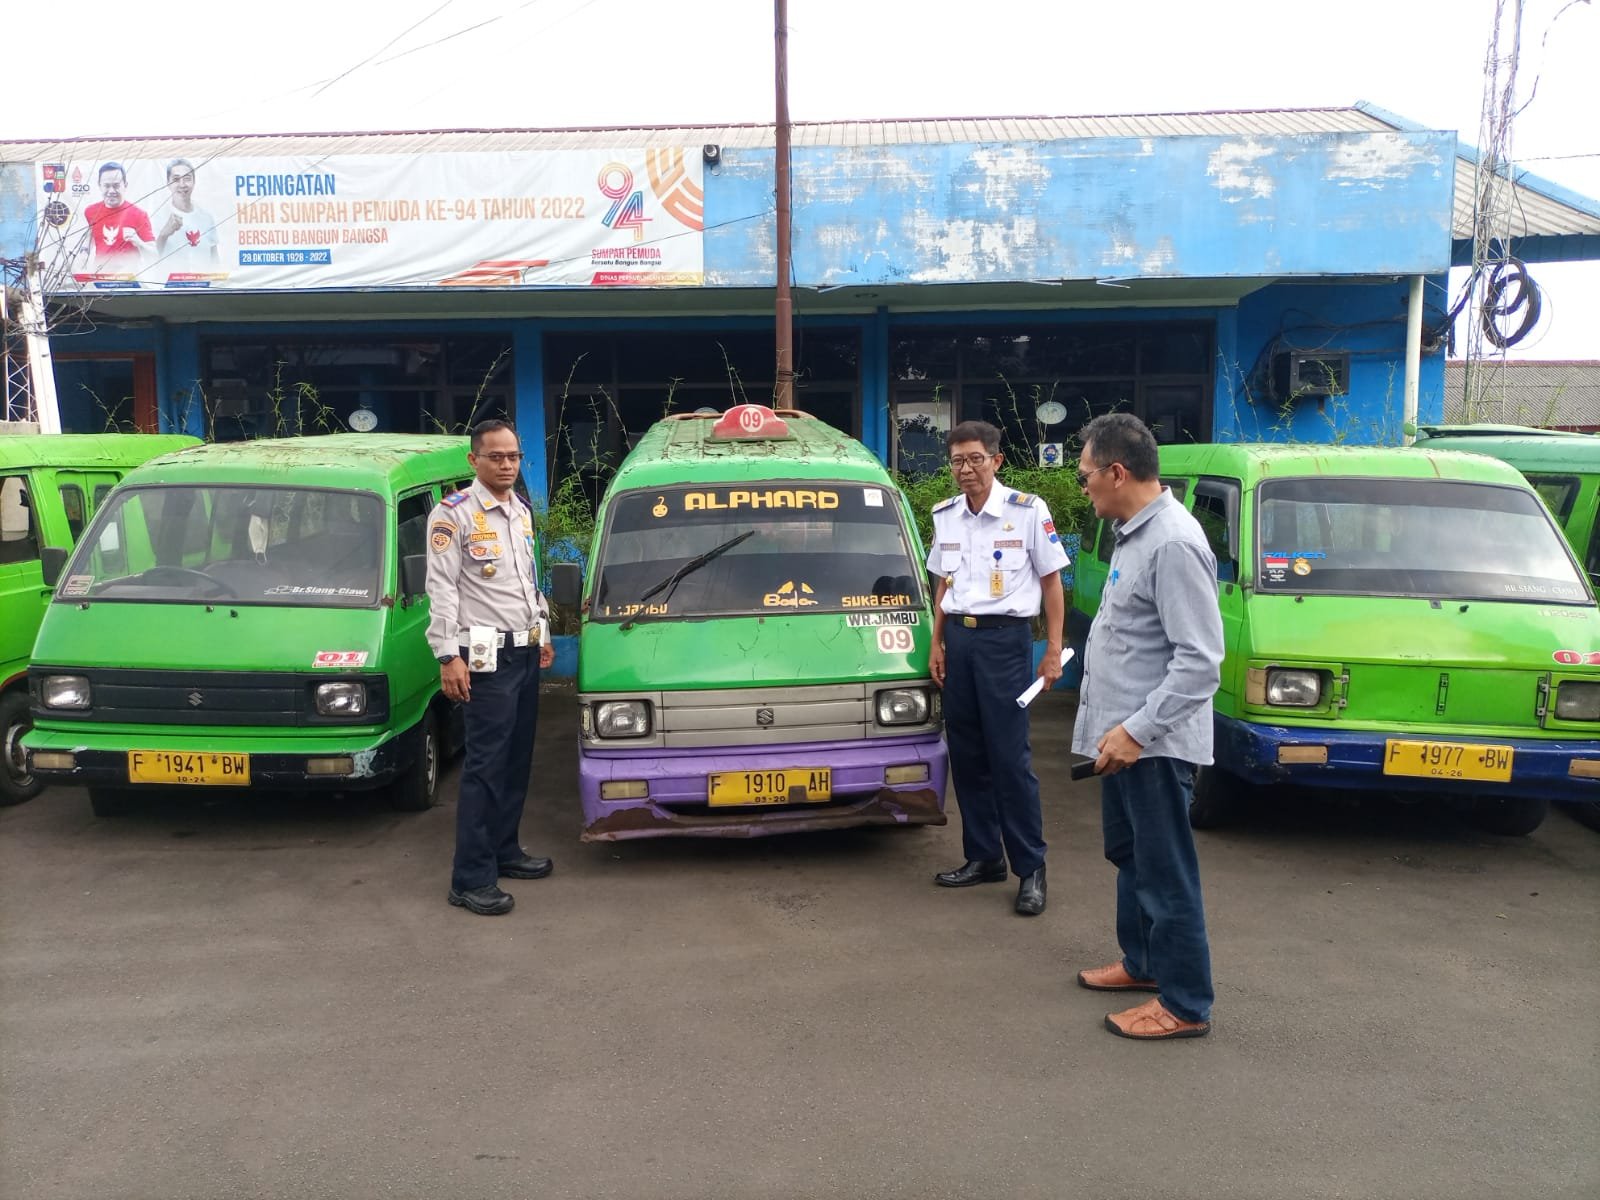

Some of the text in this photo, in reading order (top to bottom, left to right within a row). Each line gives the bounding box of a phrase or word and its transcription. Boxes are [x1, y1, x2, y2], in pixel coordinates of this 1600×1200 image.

[72, 184, 90, 192] G20
[235, 174, 336, 196] PERINGATAN
[237, 197, 585, 224] HARI SUMPAH PEMUDA KE-94 TAHUN 2022
[597, 162, 653, 241] 94
[238, 228, 389, 245] BERSATU BANGUN BANGSA
[253, 252, 285, 262] OKTOBER
[310, 251, 328, 261] 2022
[591, 247, 661, 259] SUMPAH PEMUDA
[742, 412, 761, 428] 09
[685, 491, 839, 511] ALPHARD
[848, 612, 917, 627] WR.JAMBU
[880, 629, 911, 650] 09
[133, 753, 245, 775] F 1941 BW
[1390, 743, 1510, 770] F 1977 BW
[711, 771, 829, 795] F 1910 AH
